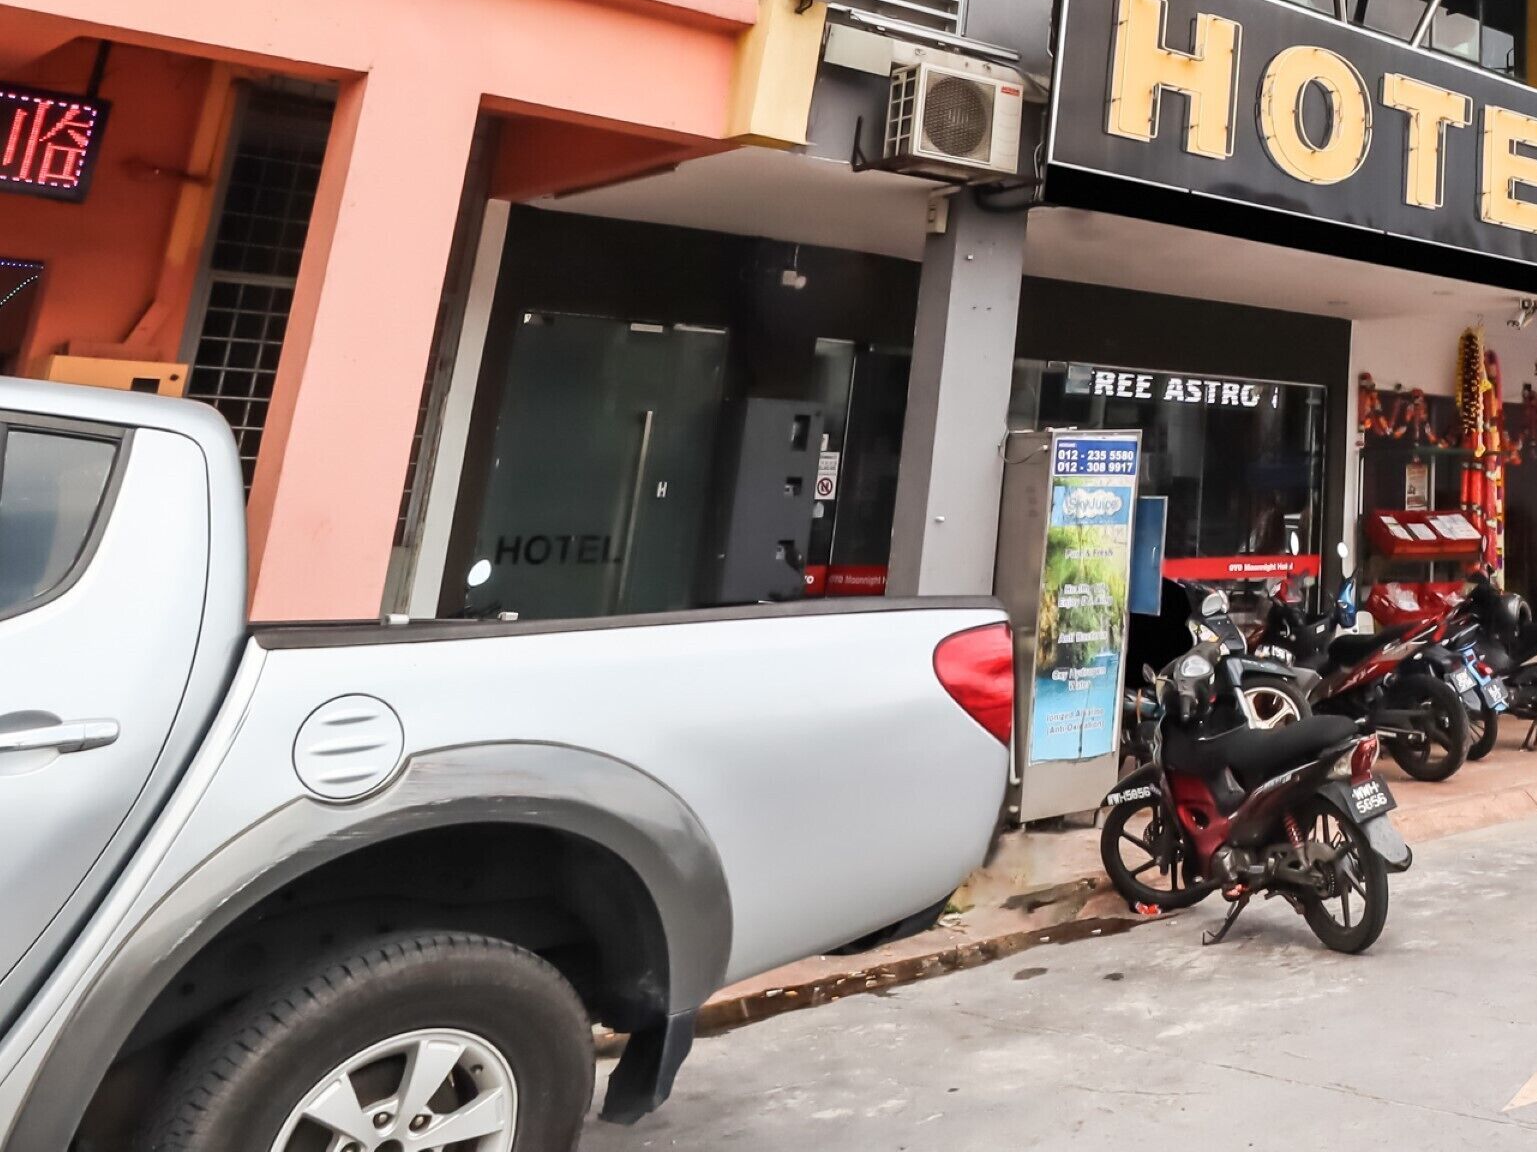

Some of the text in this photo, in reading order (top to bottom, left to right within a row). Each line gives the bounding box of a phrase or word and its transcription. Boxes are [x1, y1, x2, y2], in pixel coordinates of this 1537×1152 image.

[1089, 370, 1153, 399] REE
[1057, 449, 1078, 460] 012
[1087, 450, 1107, 460] 235
[1109, 450, 1134, 460] 5580
[1057, 462, 1078, 472] 012
[1108, 462, 1133, 472] 9917
[494, 534, 622, 565] HOTEL
